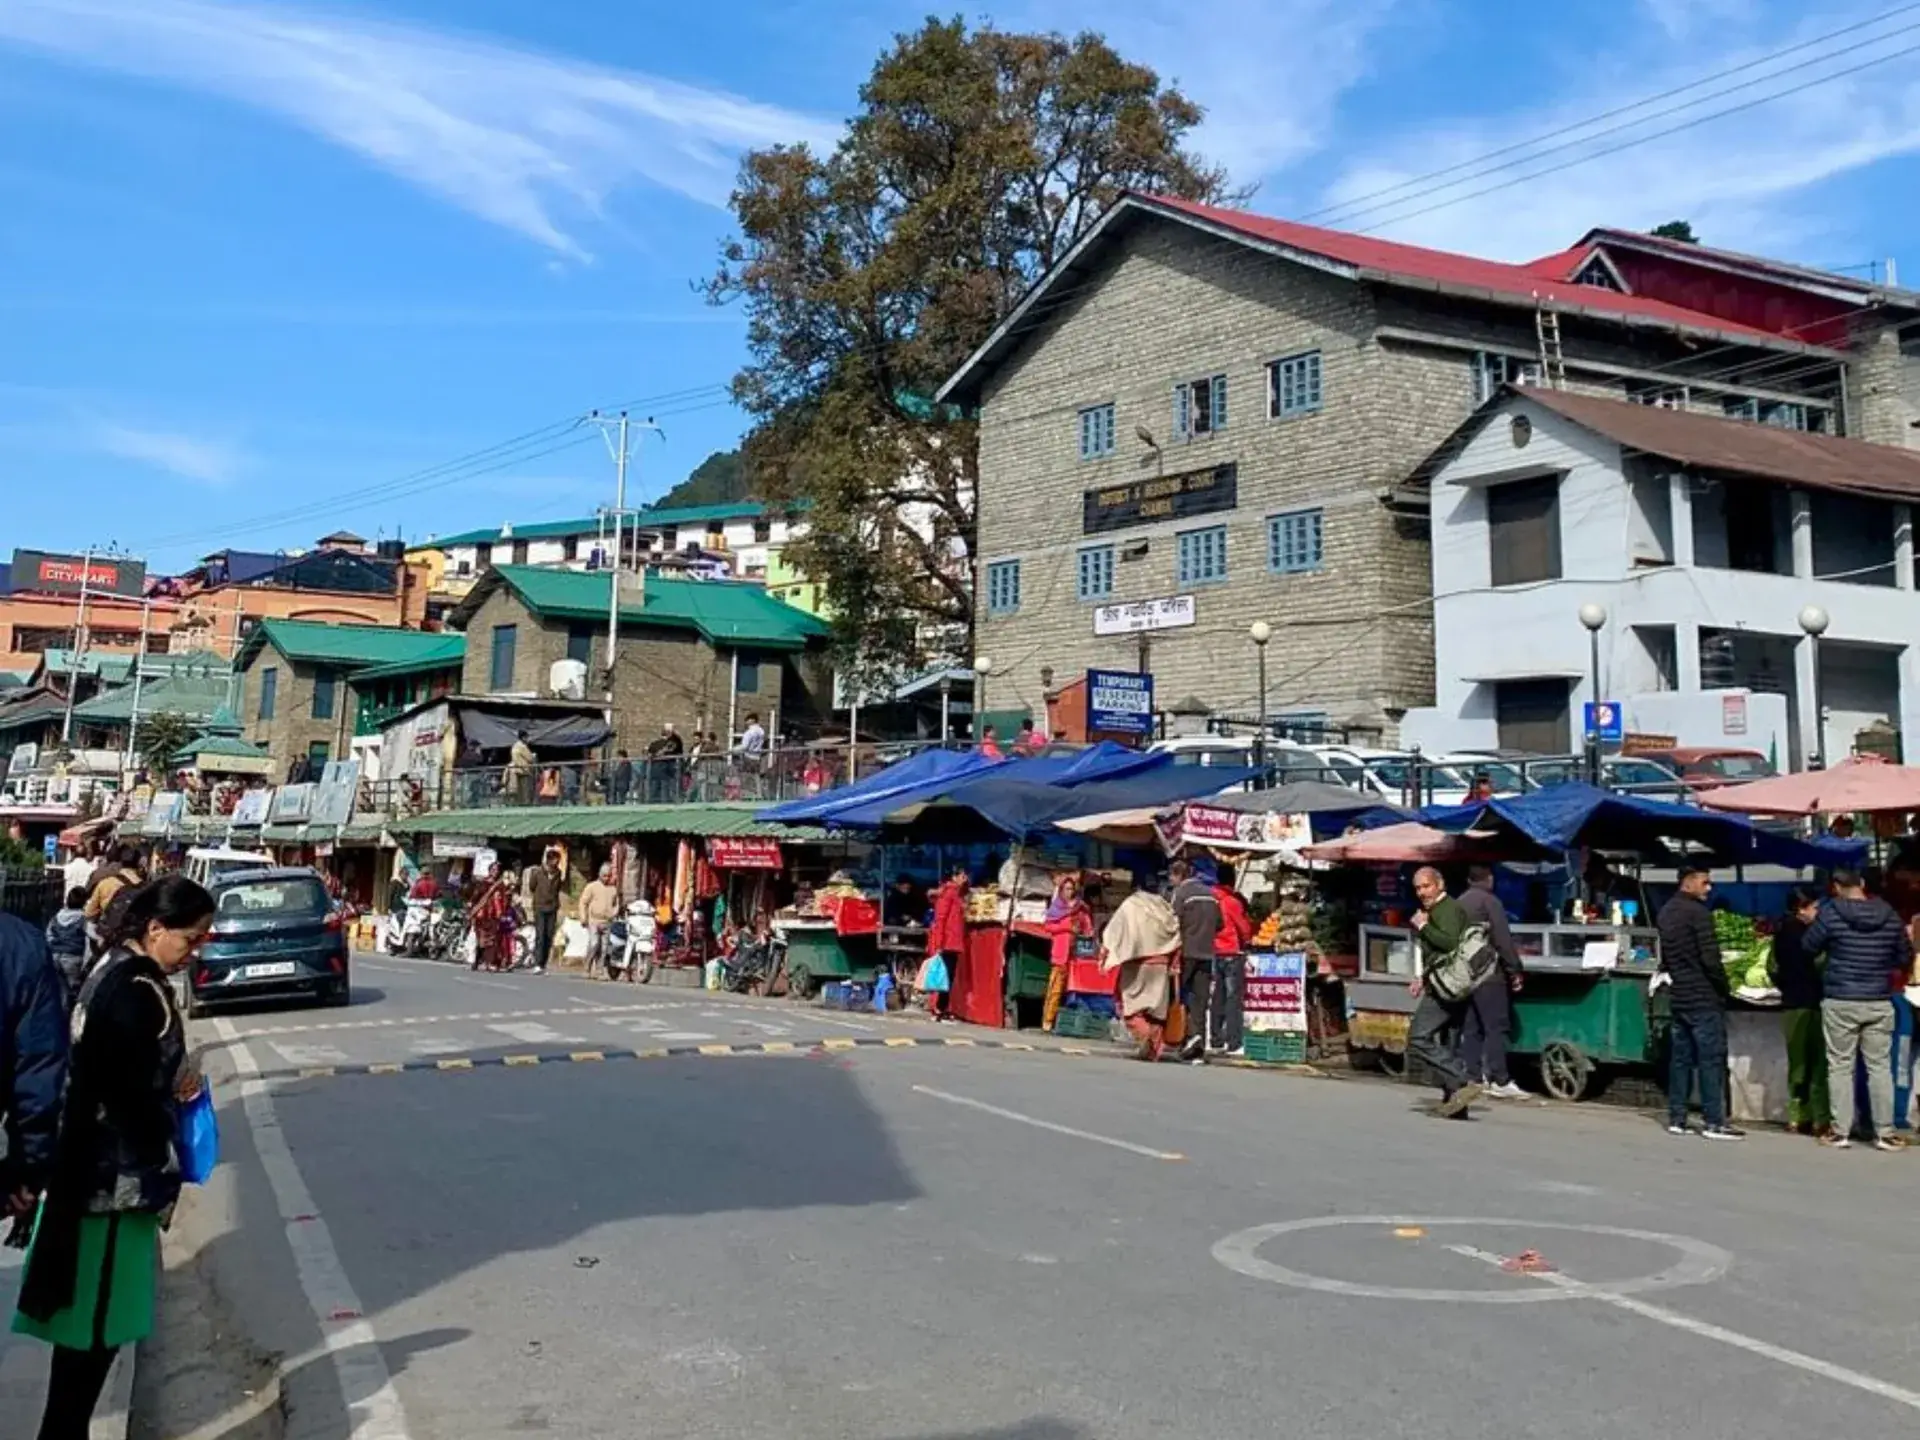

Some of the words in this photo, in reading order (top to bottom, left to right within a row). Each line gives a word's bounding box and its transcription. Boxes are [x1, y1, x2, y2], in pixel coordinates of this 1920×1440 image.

[1097, 674, 1144, 690] TEMPORARY
[1094, 688, 1147, 702] RESERVED
[1098, 700, 1142, 712] PARKING
